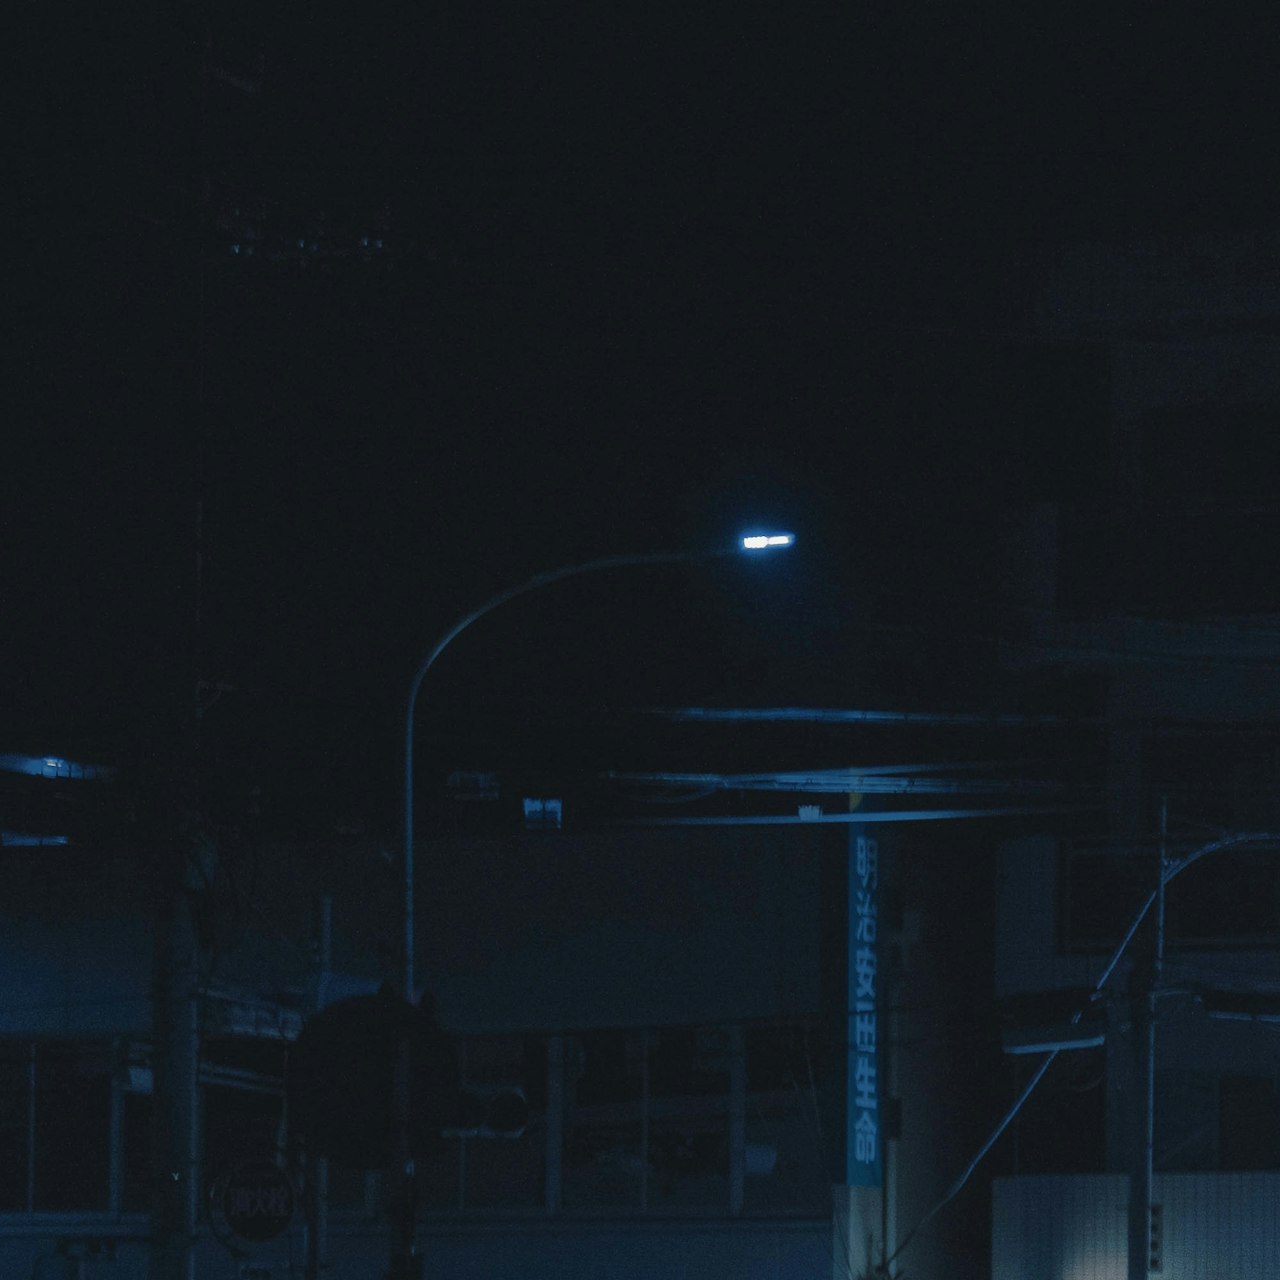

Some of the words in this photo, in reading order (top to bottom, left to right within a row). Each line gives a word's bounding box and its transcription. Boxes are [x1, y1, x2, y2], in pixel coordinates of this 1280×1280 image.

[855, 835, 878, 1165] 明治安田生命
